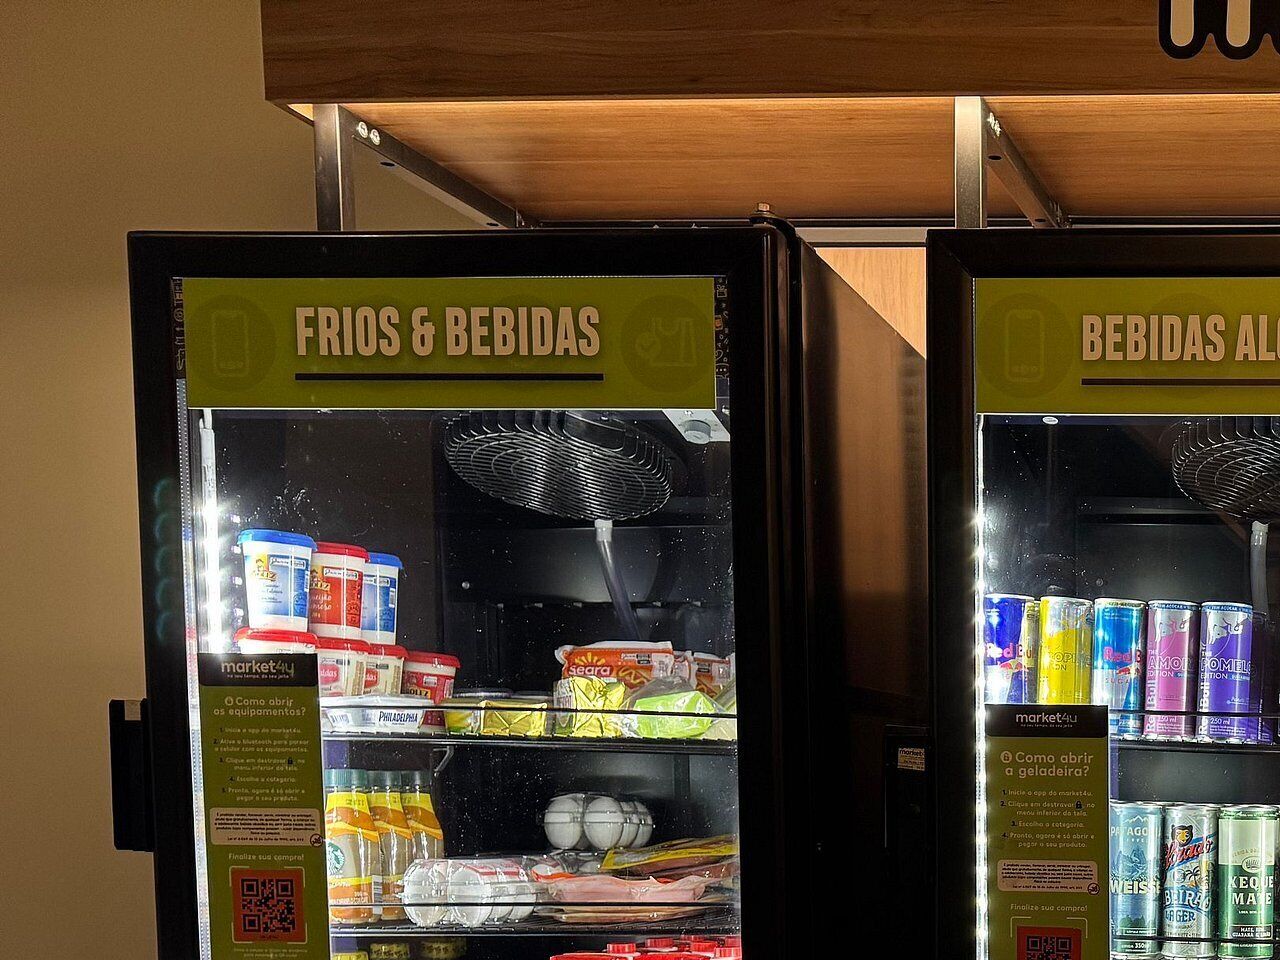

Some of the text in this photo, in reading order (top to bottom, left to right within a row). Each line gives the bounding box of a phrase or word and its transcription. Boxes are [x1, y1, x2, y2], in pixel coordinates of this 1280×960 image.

[296, 305, 600, 356] FRIOS & BEBIDAS
[1081, 314, 1226, 361] BEBIDAS
[568, 664, 611, 677] seara
[235, 697, 294, 706] Como abrir
[228, 707, 306, 718] equipamentos?
[379, 711, 418, 723] PHILADELPHIA
[1015, 712, 1078, 723] market4u
[1015, 751, 1094, 763] Como abrir
[1005, 765, 1090, 779] a geladeira?
[1231, 892, 1272, 905] MATE
[1010, 903, 1039, 911] Finalize
